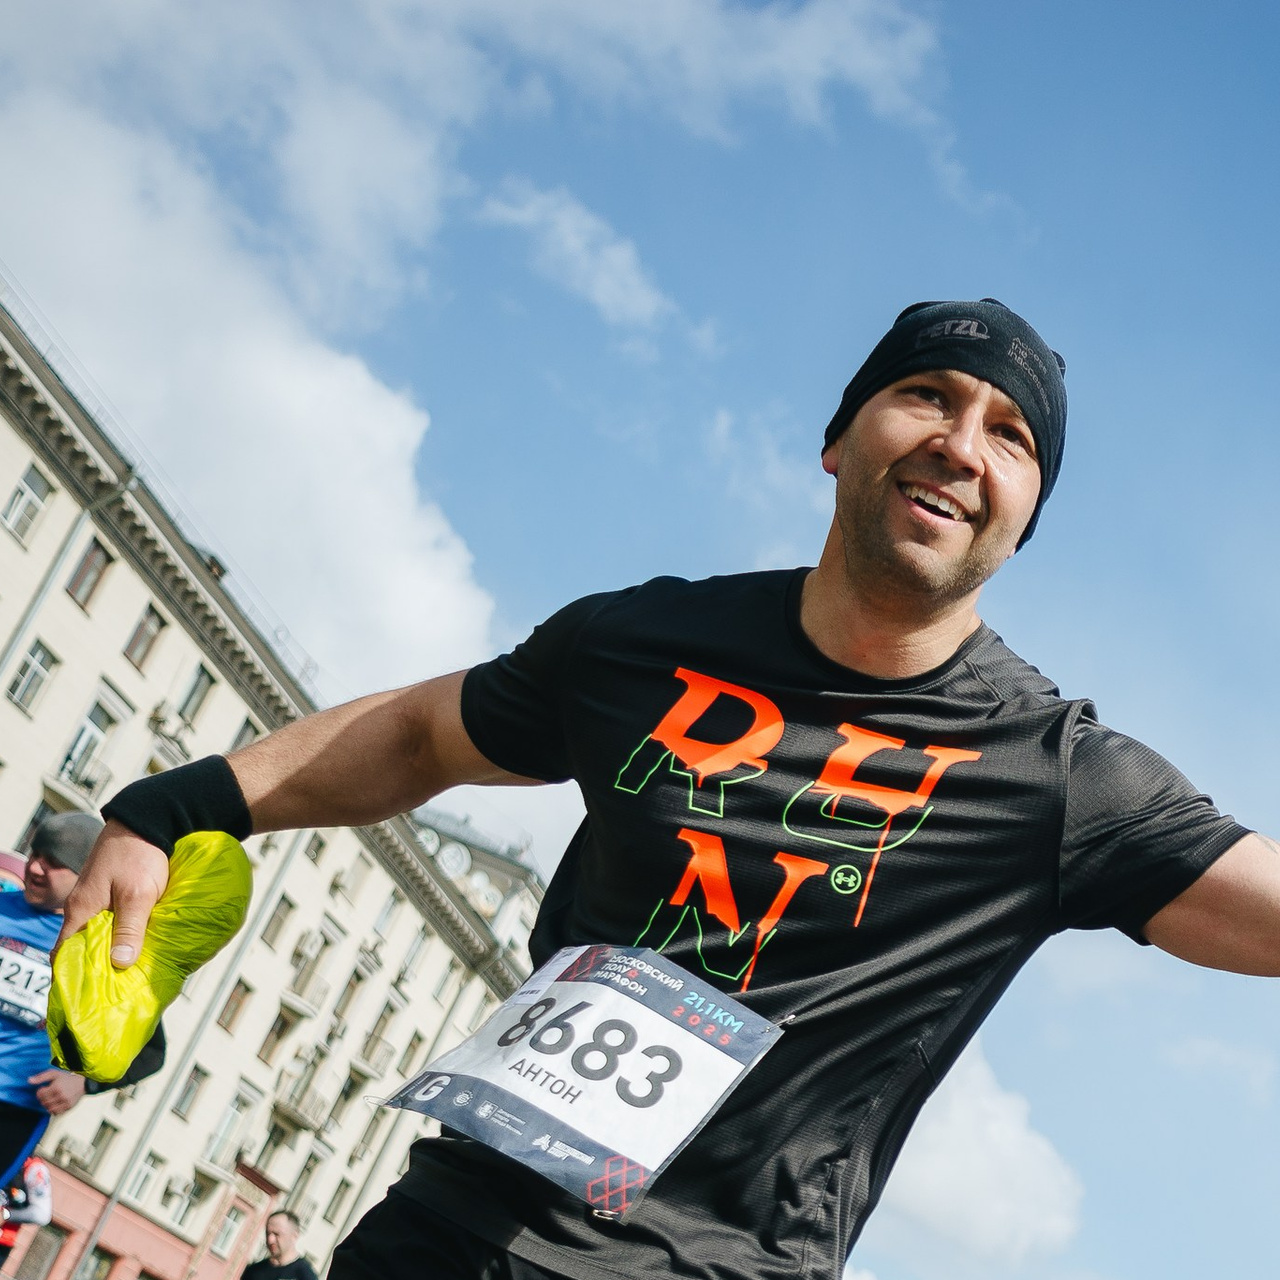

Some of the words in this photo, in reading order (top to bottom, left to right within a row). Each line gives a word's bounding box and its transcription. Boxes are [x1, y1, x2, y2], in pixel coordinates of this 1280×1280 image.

[1011, 341, 1028, 359] the
[593, 969, 649, 998] МАРАФОН
[609, 953, 685, 993] МОСКОВСКИЙ
[671, 1005, 731, 1047] 2025
[496, 997, 684, 1109] 8683
[414, 1075, 452, 1102] G
[508, 1056, 584, 1105] АНТОН
